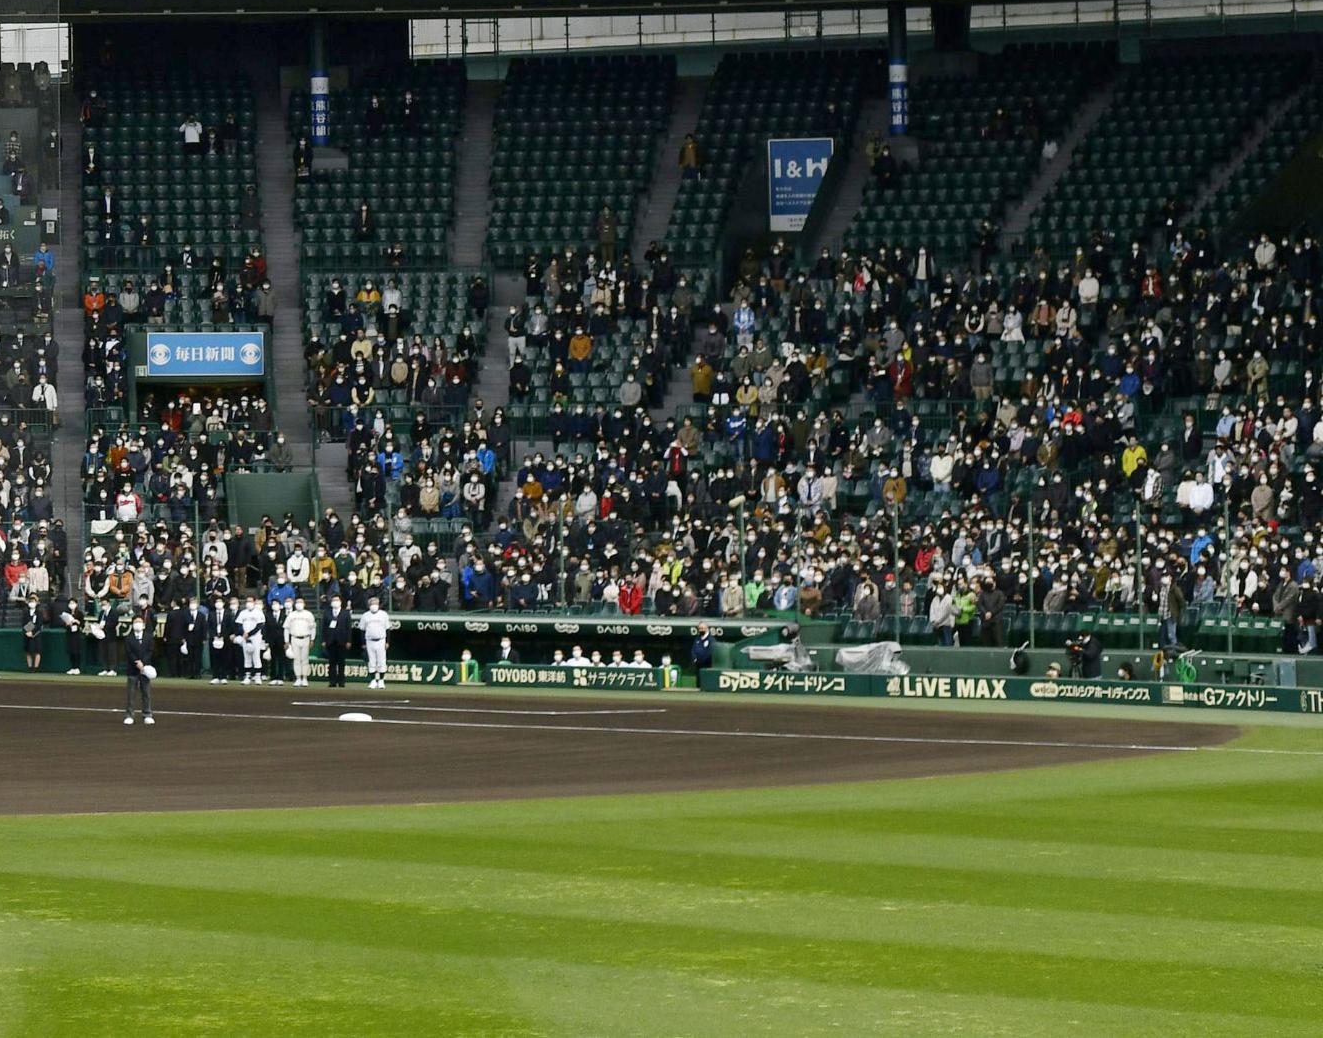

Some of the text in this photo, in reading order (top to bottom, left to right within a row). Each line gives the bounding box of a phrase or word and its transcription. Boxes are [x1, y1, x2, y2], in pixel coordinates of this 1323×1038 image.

[176, 346, 236, 362] 毎日新聞
[417, 622, 449, 631] DAISO
[506, 624, 538, 633] DAISO
[596, 626, 630, 635] DAISO
[411, 664, 454, 682] セノン
[490, 668, 535, 684] TOYOBO
[587, 671, 647, 687] サラダクラブ
[719, 673, 845, 692] DyDo ダイドードリンコ
[956, 678, 1007, 699] MAX
[1058, 685, 1151, 700] ウエルシアホールディングス
[1203, 687, 1278, 708] Gファクトリー
